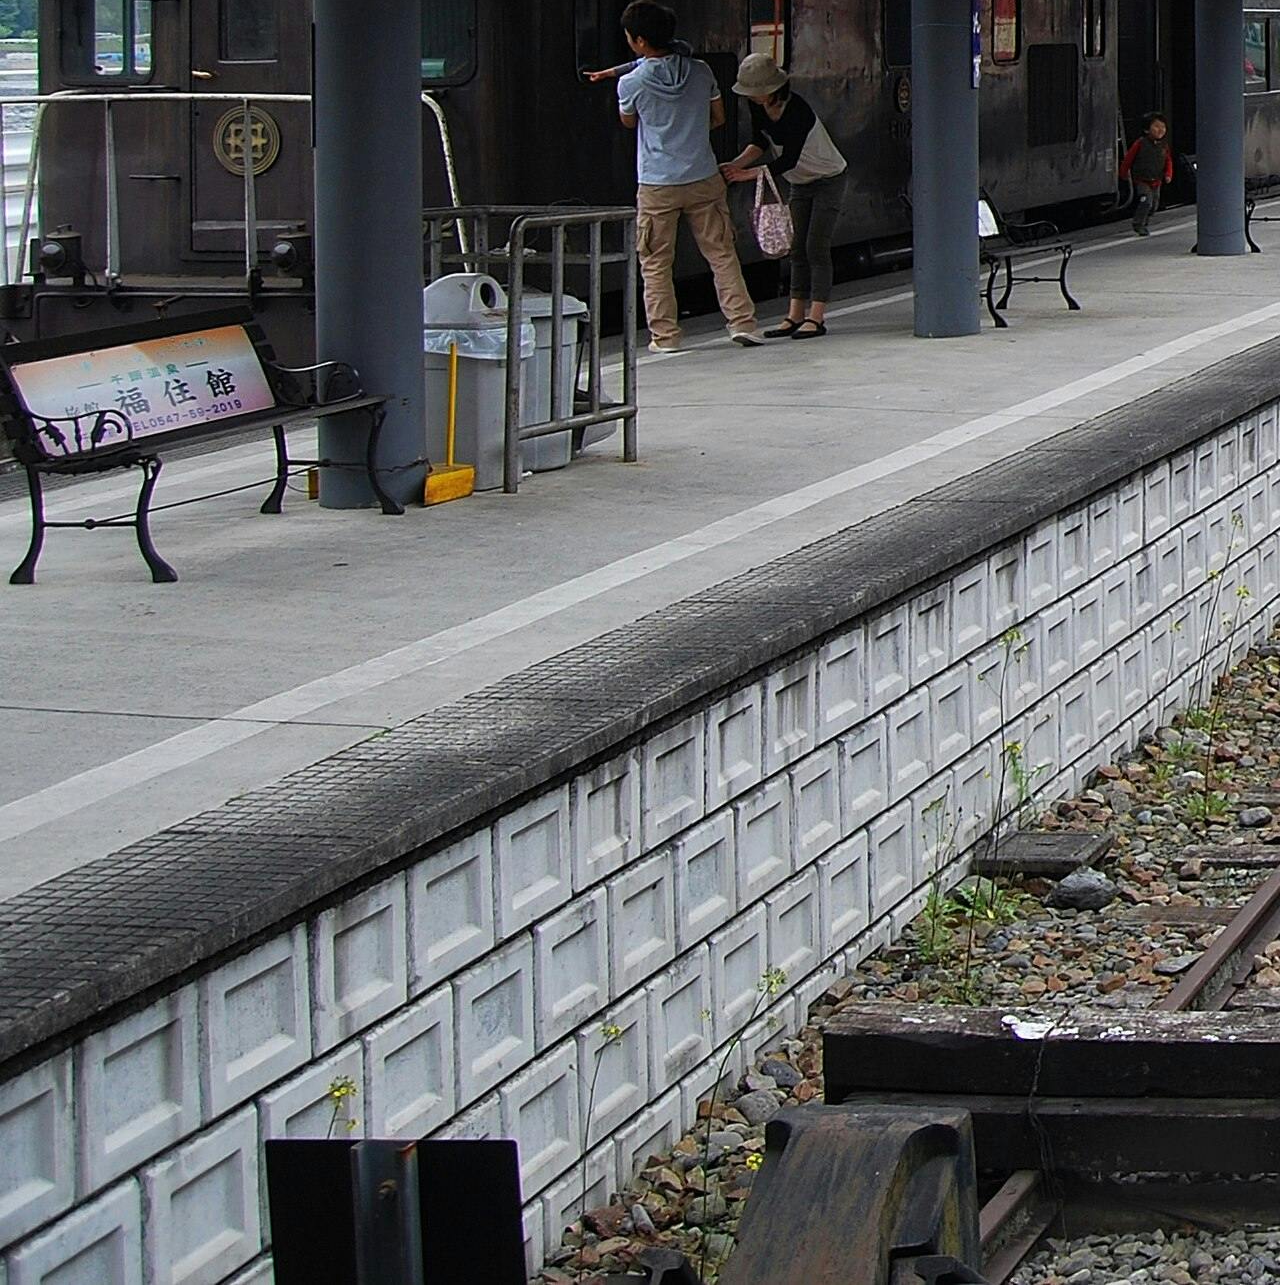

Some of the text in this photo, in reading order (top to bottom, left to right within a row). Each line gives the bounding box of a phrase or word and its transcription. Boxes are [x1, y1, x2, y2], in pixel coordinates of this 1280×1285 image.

[114, 368, 238, 416] 福住館
[126, 400, 243, 432] EL0547-59-2019
